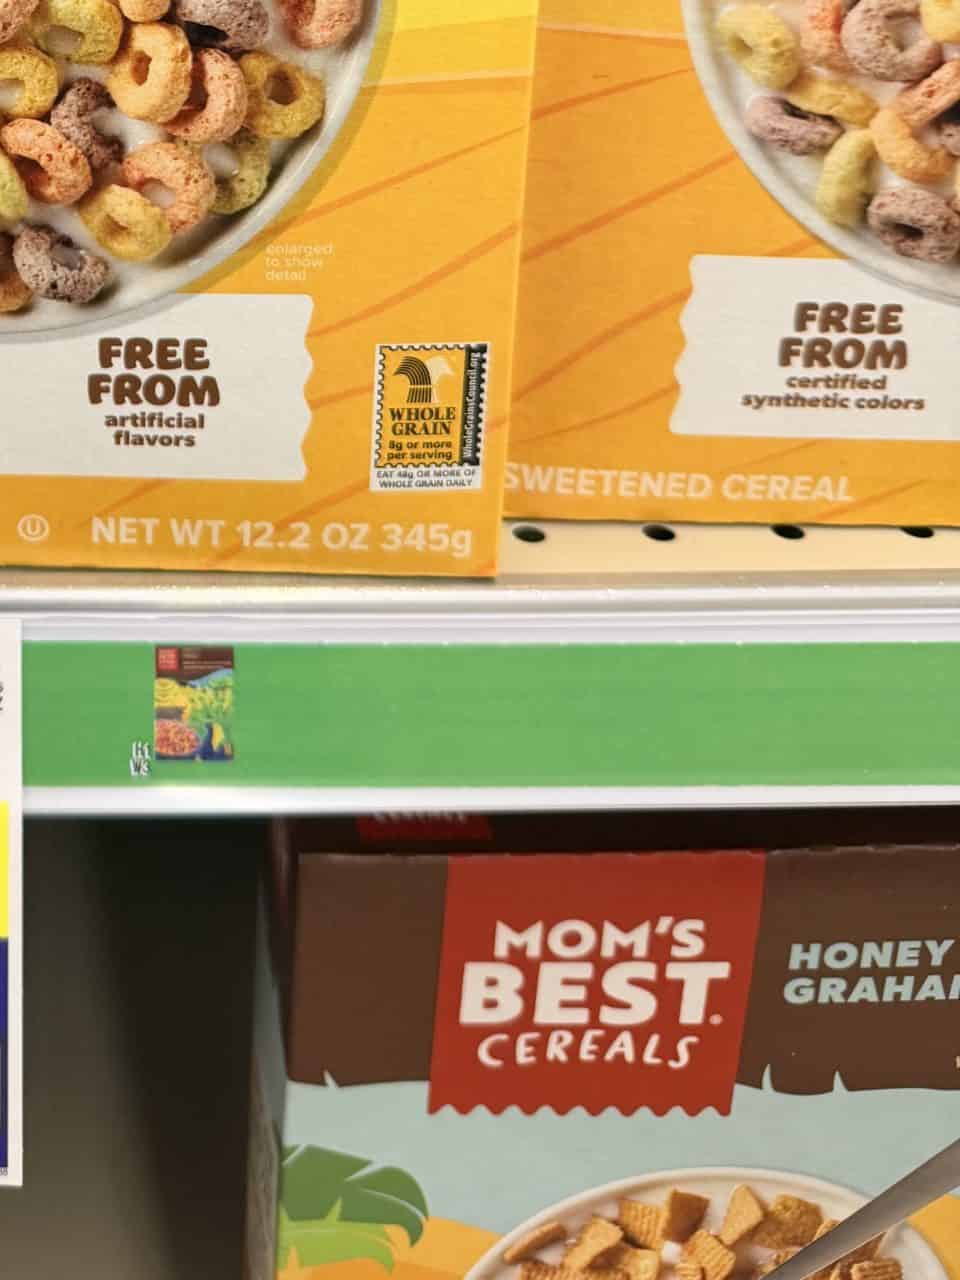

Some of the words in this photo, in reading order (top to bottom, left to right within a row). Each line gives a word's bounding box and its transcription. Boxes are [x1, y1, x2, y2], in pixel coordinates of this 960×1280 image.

[264, 243, 334, 260] enlarged
[264, 269, 307, 282] detail
[794, 301, 904, 335] FREE
[98, 336, 211, 370] FREE
[778, 337, 908, 370] FROM
[87, 373, 220, 407] FROM
[786, 373, 888, 391] certified
[741, 392, 851, 411] synthetic
[855, 395, 926, 412] colors
[104, 411, 206, 429] artificial
[388, 407, 456, 421] WHOLE
[391, 421, 452, 436] GRAIN
[113, 430, 197, 448] flavors
[406, 441, 419, 450] or
[422, 440, 453, 450] more
[386, 451, 407, 462] per
[409, 449, 453, 462] serving
[376, 470, 394, 479] EAT
[504, 462, 711, 500] SWEETENED
[721, 472, 855, 503] CEREAL
[379, 479, 413, 489] WHOLE
[415, 479, 444, 489] GRAIN
[90, 516, 160, 546] NET
[169, 518, 227, 548] WT
[239, 519, 310, 551] 12.2
[321, 521, 371, 552] OZ
[380, 523, 474, 558] 345g
[493, 915, 706, 960] MOM'S
[787, 939, 955, 972] HONEY
[476, 1029, 700, 1069] CEREALS
